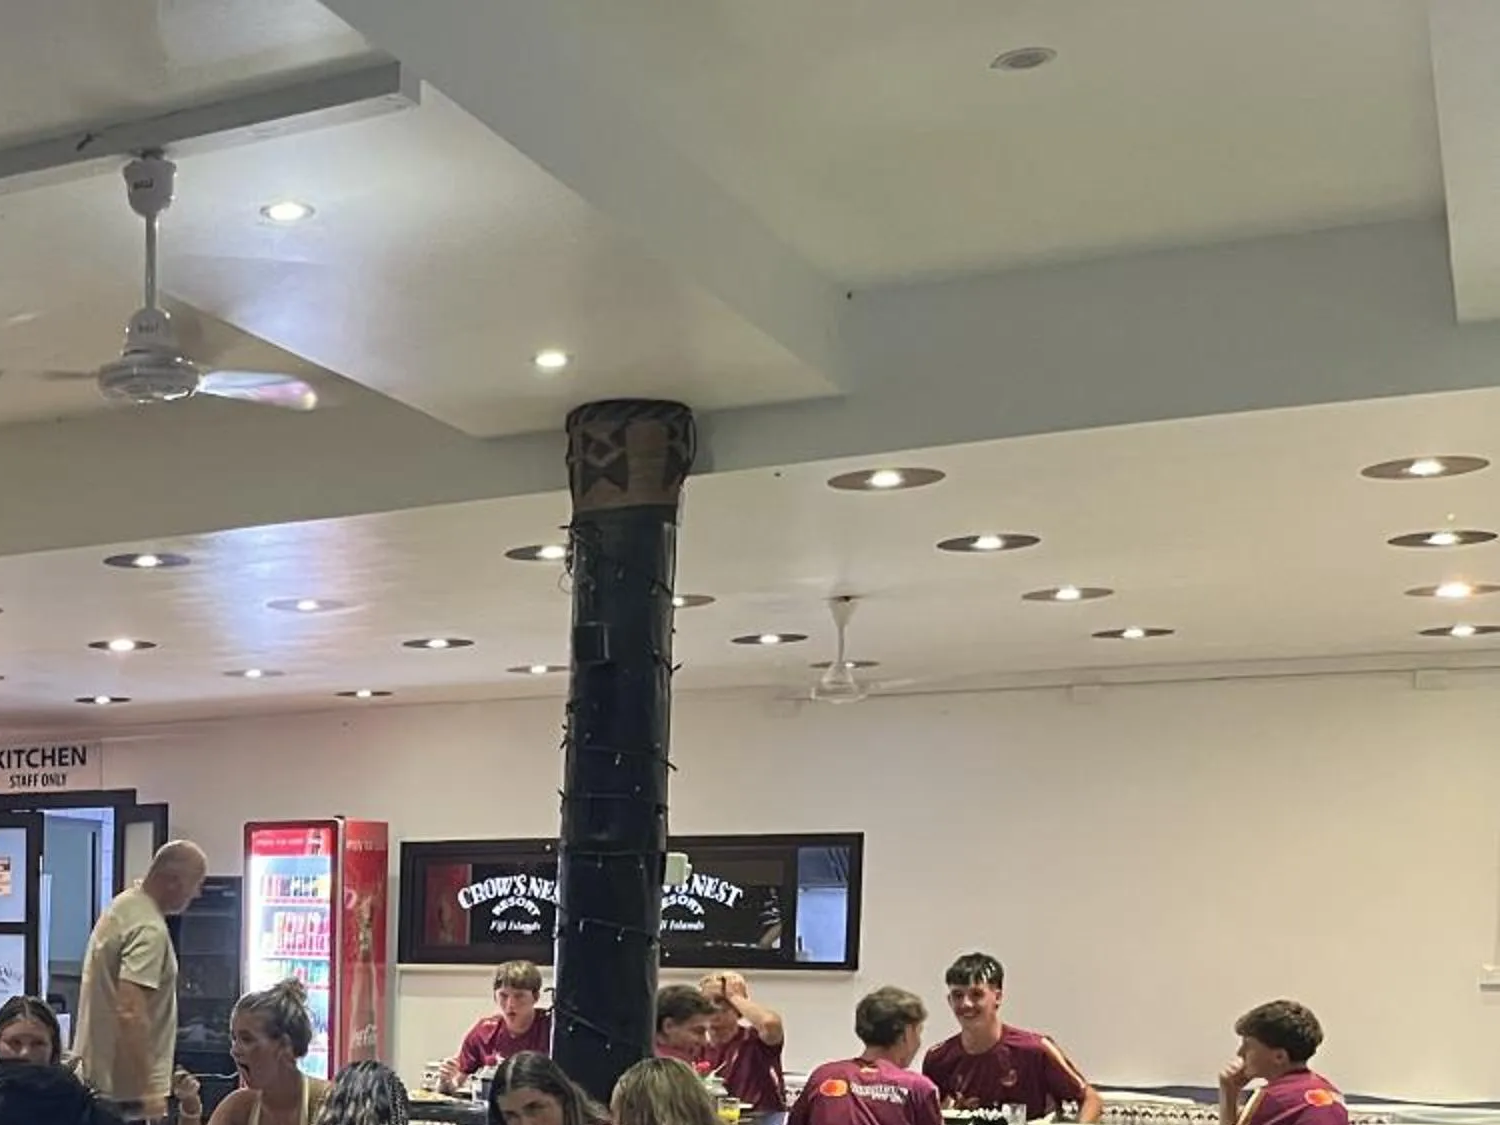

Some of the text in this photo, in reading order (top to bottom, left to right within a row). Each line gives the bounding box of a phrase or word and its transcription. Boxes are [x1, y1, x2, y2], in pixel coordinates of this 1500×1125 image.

[9, 771, 67, 788] STAFF ONLY
[457, 873, 527, 910] CROW'S
[660, 894, 705, 915] ESORT
[691, 873, 743, 908] NEST
